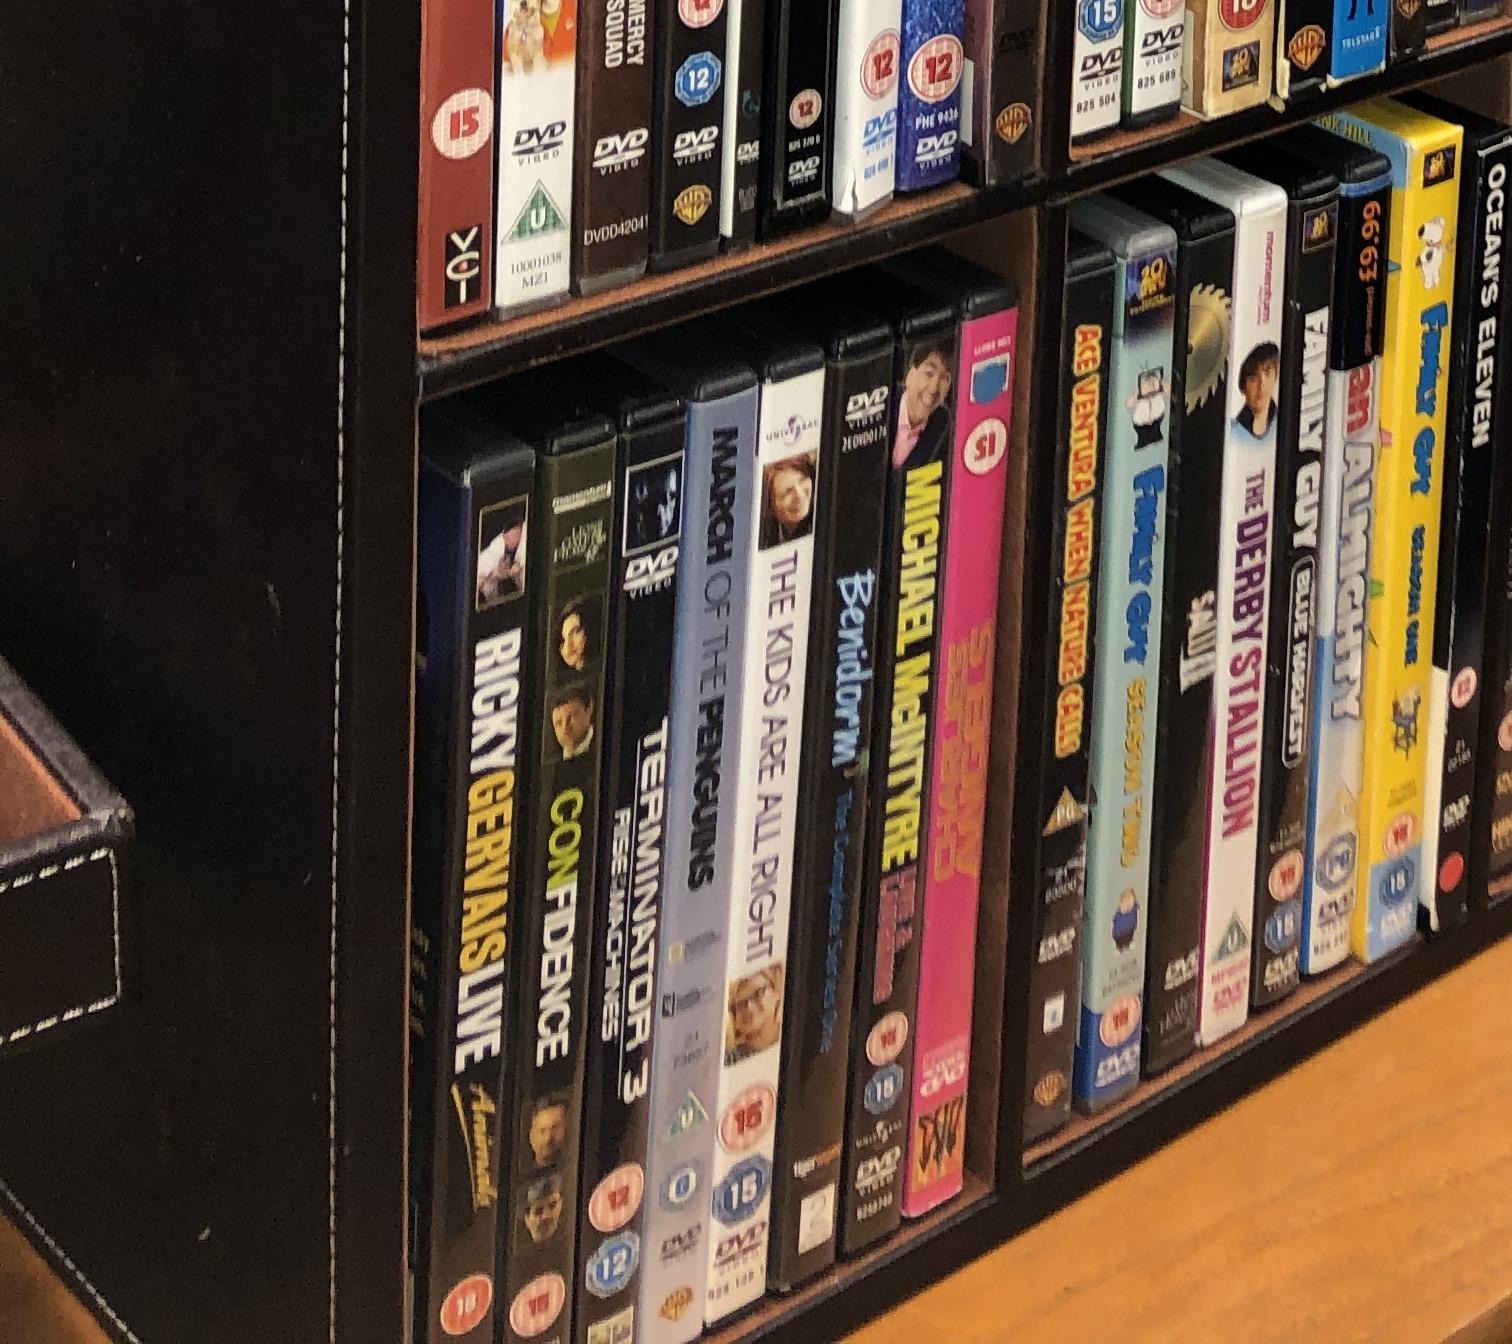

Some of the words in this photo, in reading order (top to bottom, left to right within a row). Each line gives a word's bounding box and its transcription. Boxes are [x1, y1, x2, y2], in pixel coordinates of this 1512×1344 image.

[448, 107, 480, 141] 15
[1261, 228, 1276, 326] momentum
[1479, 161, 1507, 310] OCEAN'S
[1074, 323, 1103, 376] ACE
[1298, 304, 1330, 454] FAMILY
[1471, 314, 1498, 450] ELEVEN
[845, 385, 889, 415] DVD
[1067, 374, 1101, 503] VENTURA
[1244, 467, 1266, 513] THE
[1292, 450, 1323, 550] GUY
[623, 546, 679, 580] DVD
[766, 550, 799, 620] THE
[1064, 499, 1095, 584] WHEN
[1230, 510, 1270, 645] DERBY
[761, 622, 795, 708] KIDS
[830, 568, 876, 769] Benidorm
[1057, 579, 1091, 686] NATURE
[469, 627, 522, 775] RICKY
[1054, 681, 1085, 760] CALLS
[1221, 647, 1264, 843] STALLION
[757, 714, 788, 789] ARE
[459, 769, 515, 975] GERVAIS
[752, 792, 784, 856] ALL
[625, 715, 669, 1053] TERMINATOR
[745, 850, 780, 965] RIGHT
[454, 957, 506, 1075] LIVE
[622, 1057, 649, 1105] 3
